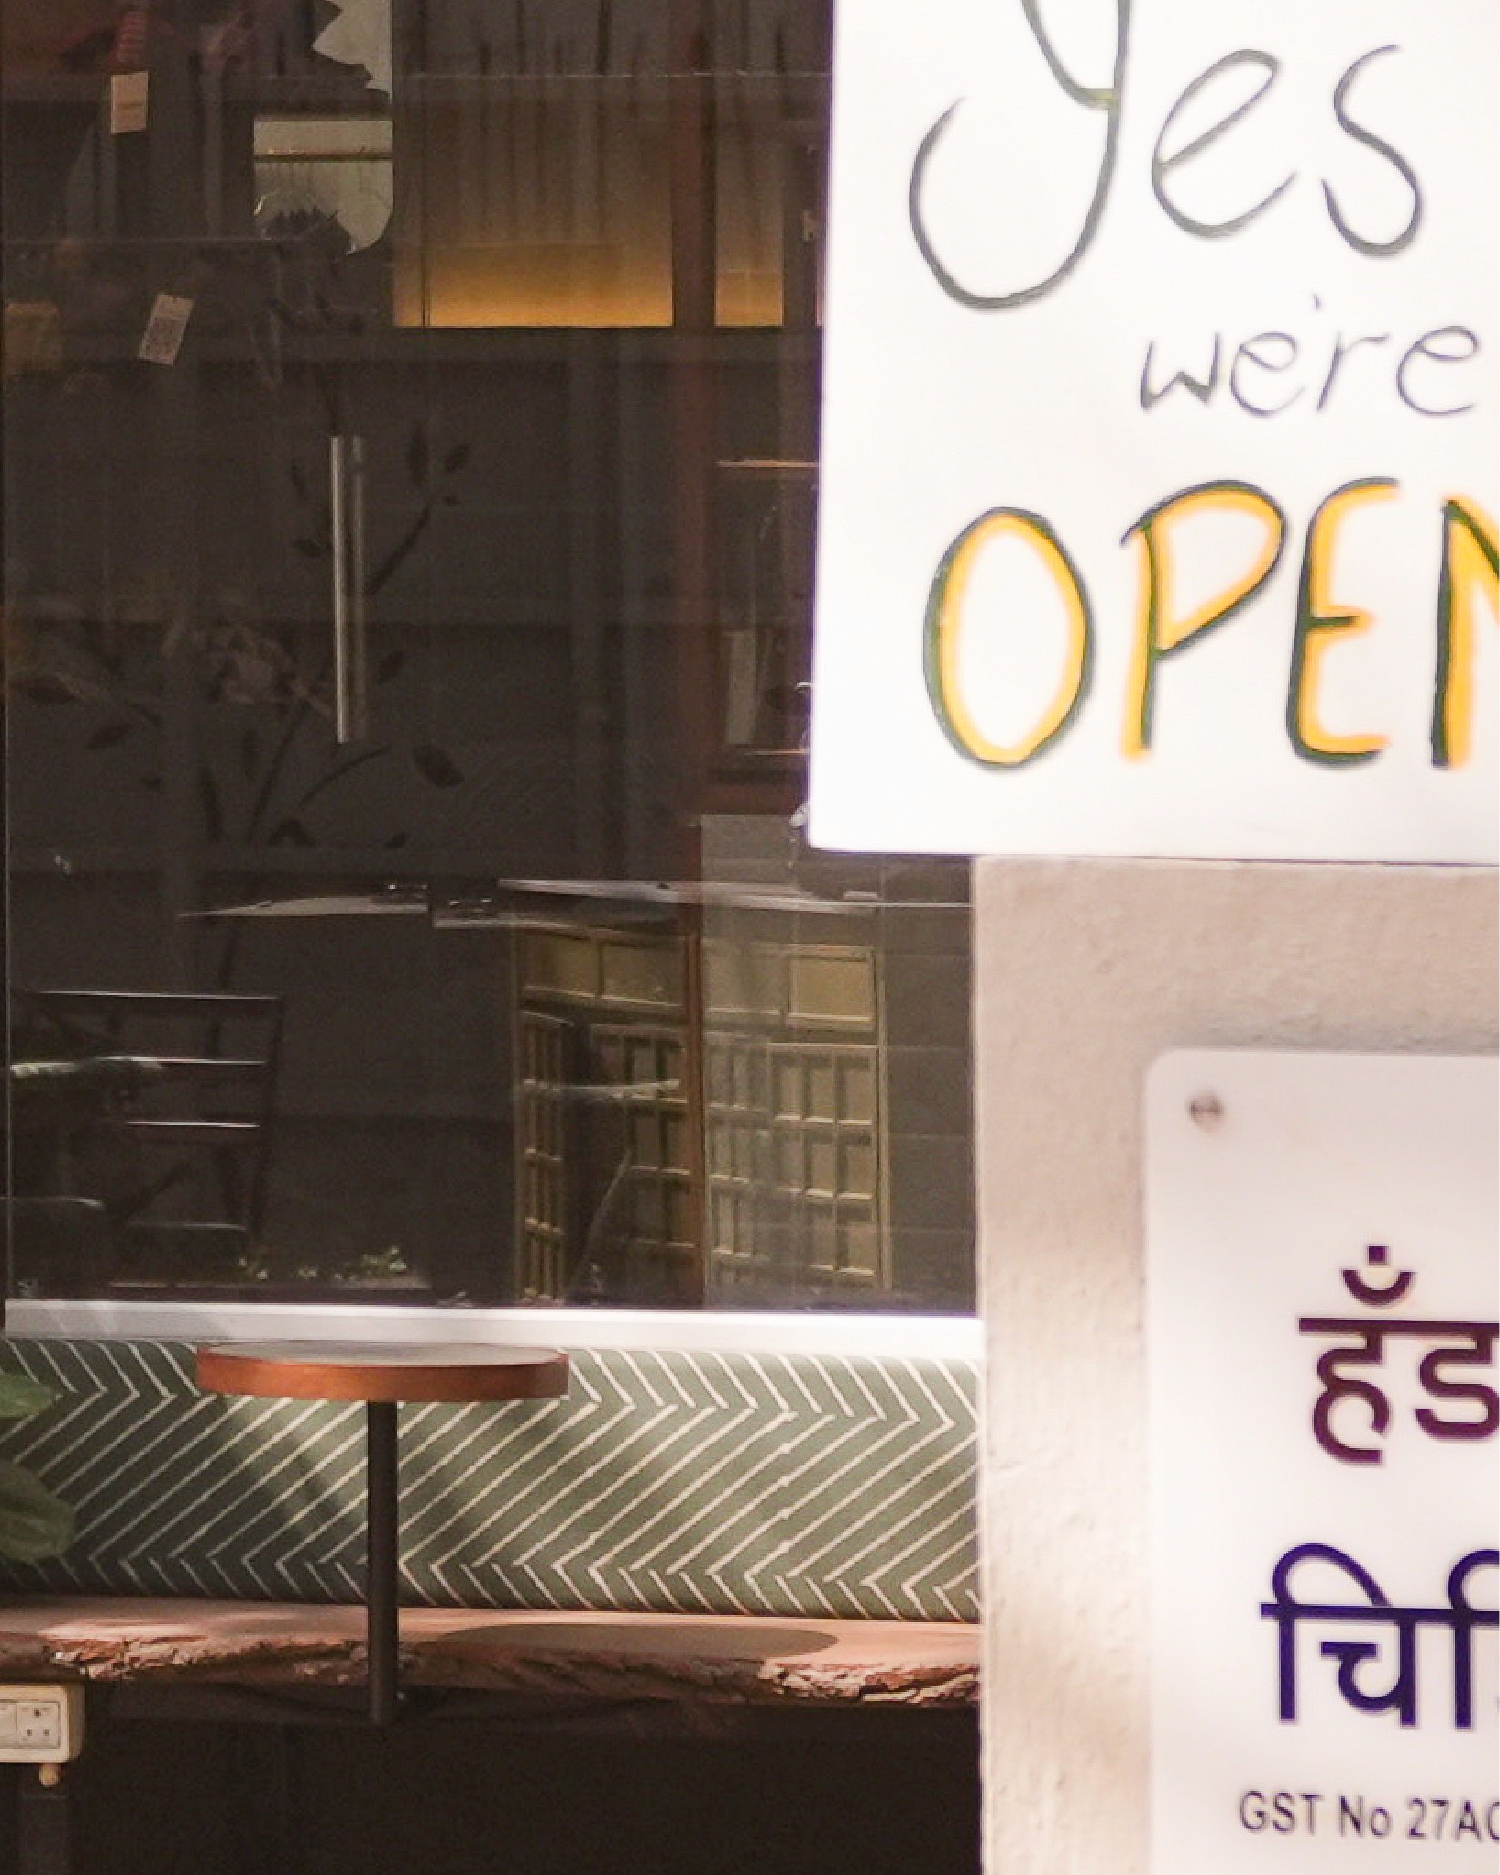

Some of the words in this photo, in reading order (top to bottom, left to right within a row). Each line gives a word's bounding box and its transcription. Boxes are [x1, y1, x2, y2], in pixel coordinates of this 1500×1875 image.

[1138, 292, 1480, 418] we're
[1239, 1789, 1324, 1836] GST
[1337, 1794, 1393, 1839] No
